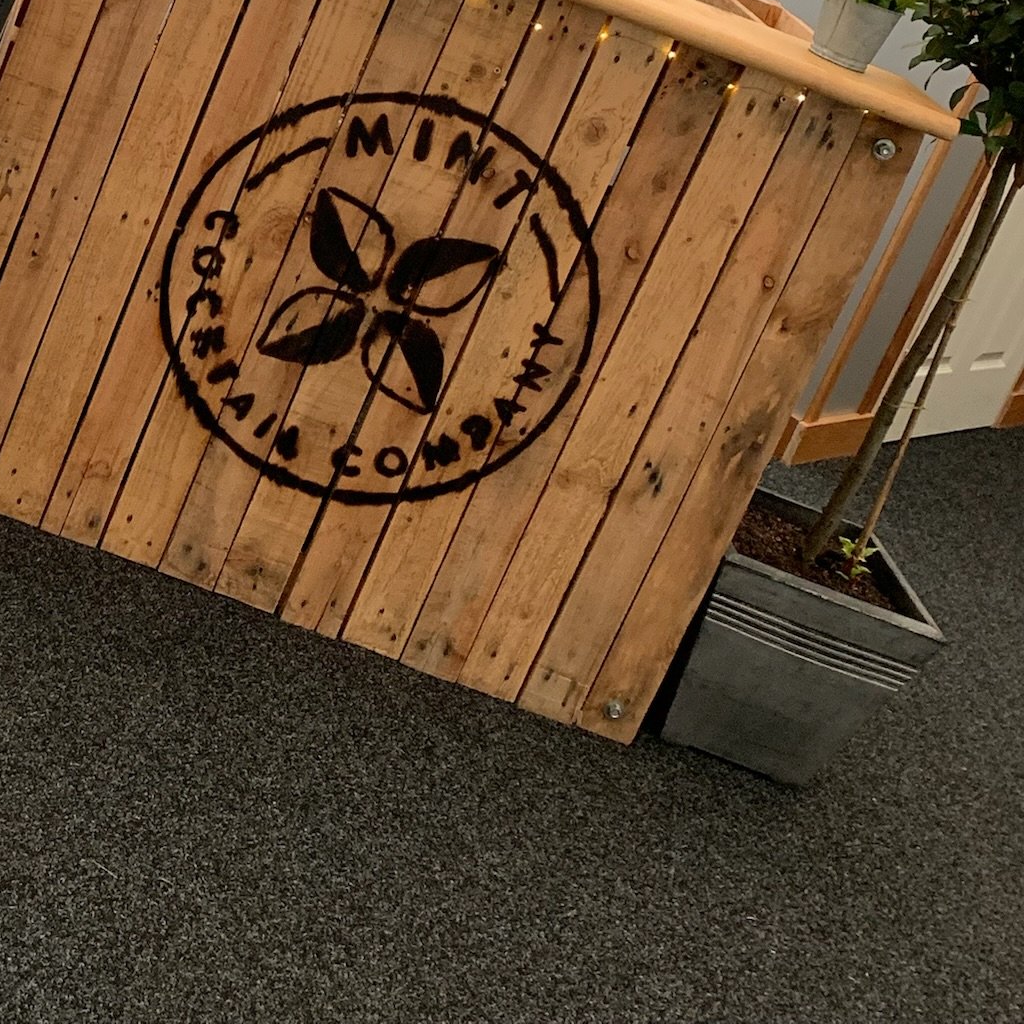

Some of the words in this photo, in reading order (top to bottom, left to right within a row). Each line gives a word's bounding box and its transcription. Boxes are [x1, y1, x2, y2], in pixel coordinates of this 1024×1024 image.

[345, 113, 538, 210] MINT
[186, 209, 299, 461] COCKTAIL
[331, 323, 563, 478] COMPANY
